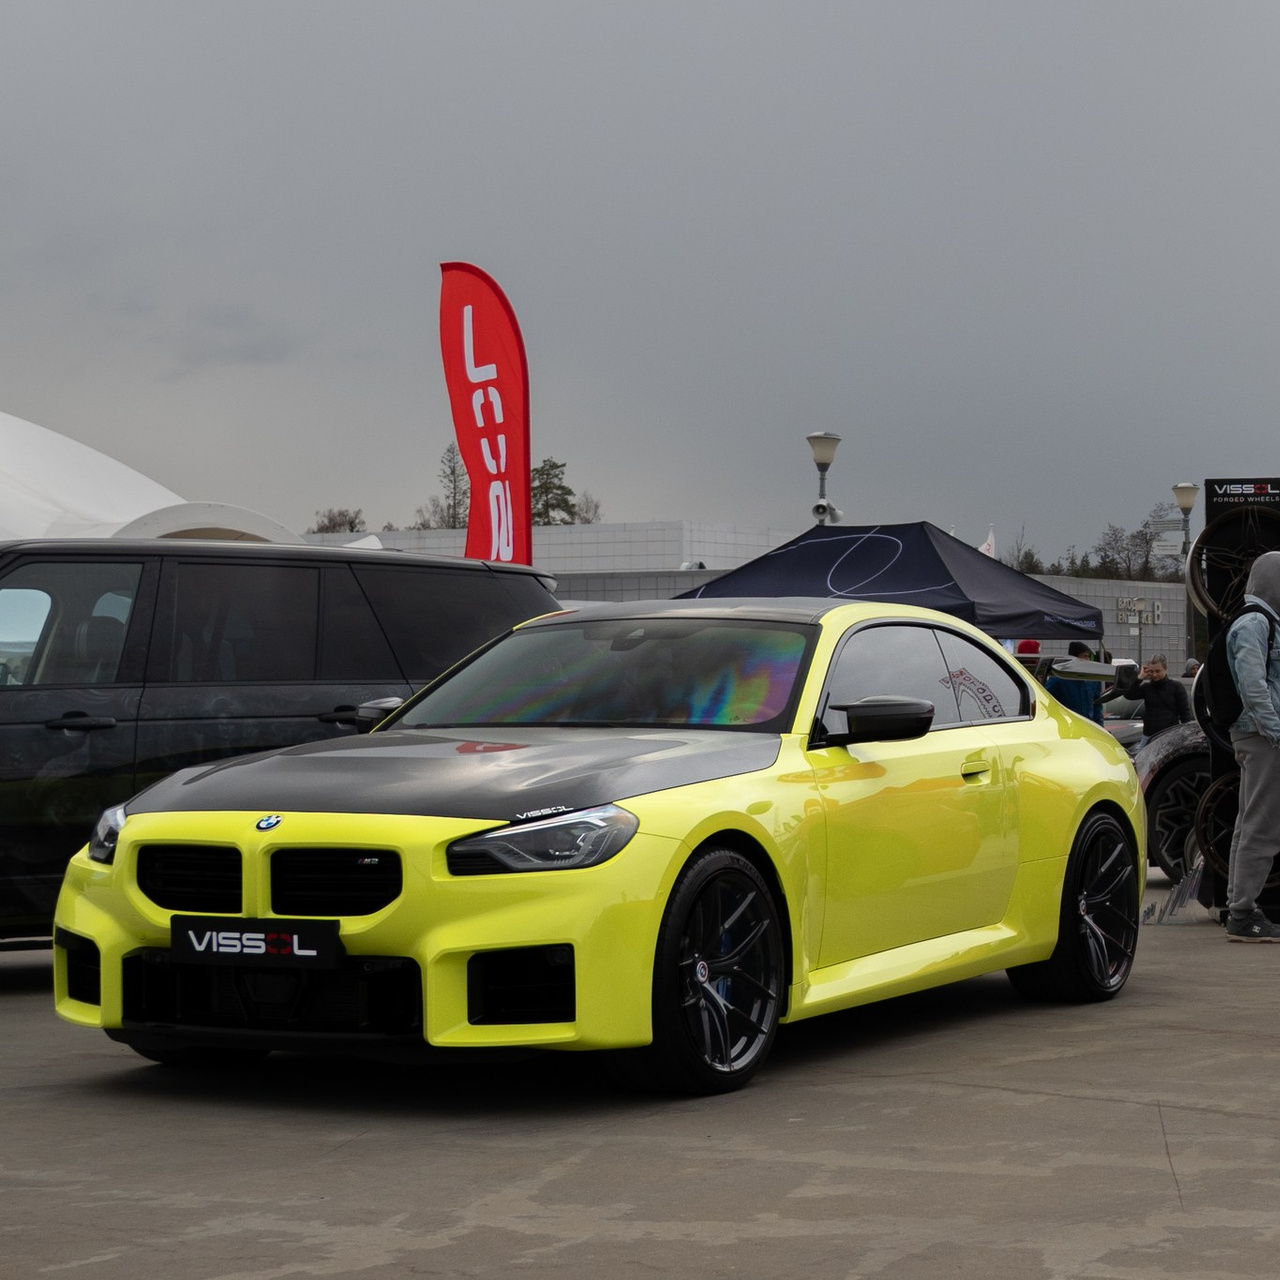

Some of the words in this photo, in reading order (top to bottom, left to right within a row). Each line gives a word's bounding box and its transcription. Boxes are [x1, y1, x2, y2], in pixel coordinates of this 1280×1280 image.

[1214, 483, 1280, 494] VISSOL
[516, 805, 575, 819] VISSOL
[187, 930, 318, 956] VISSOL
